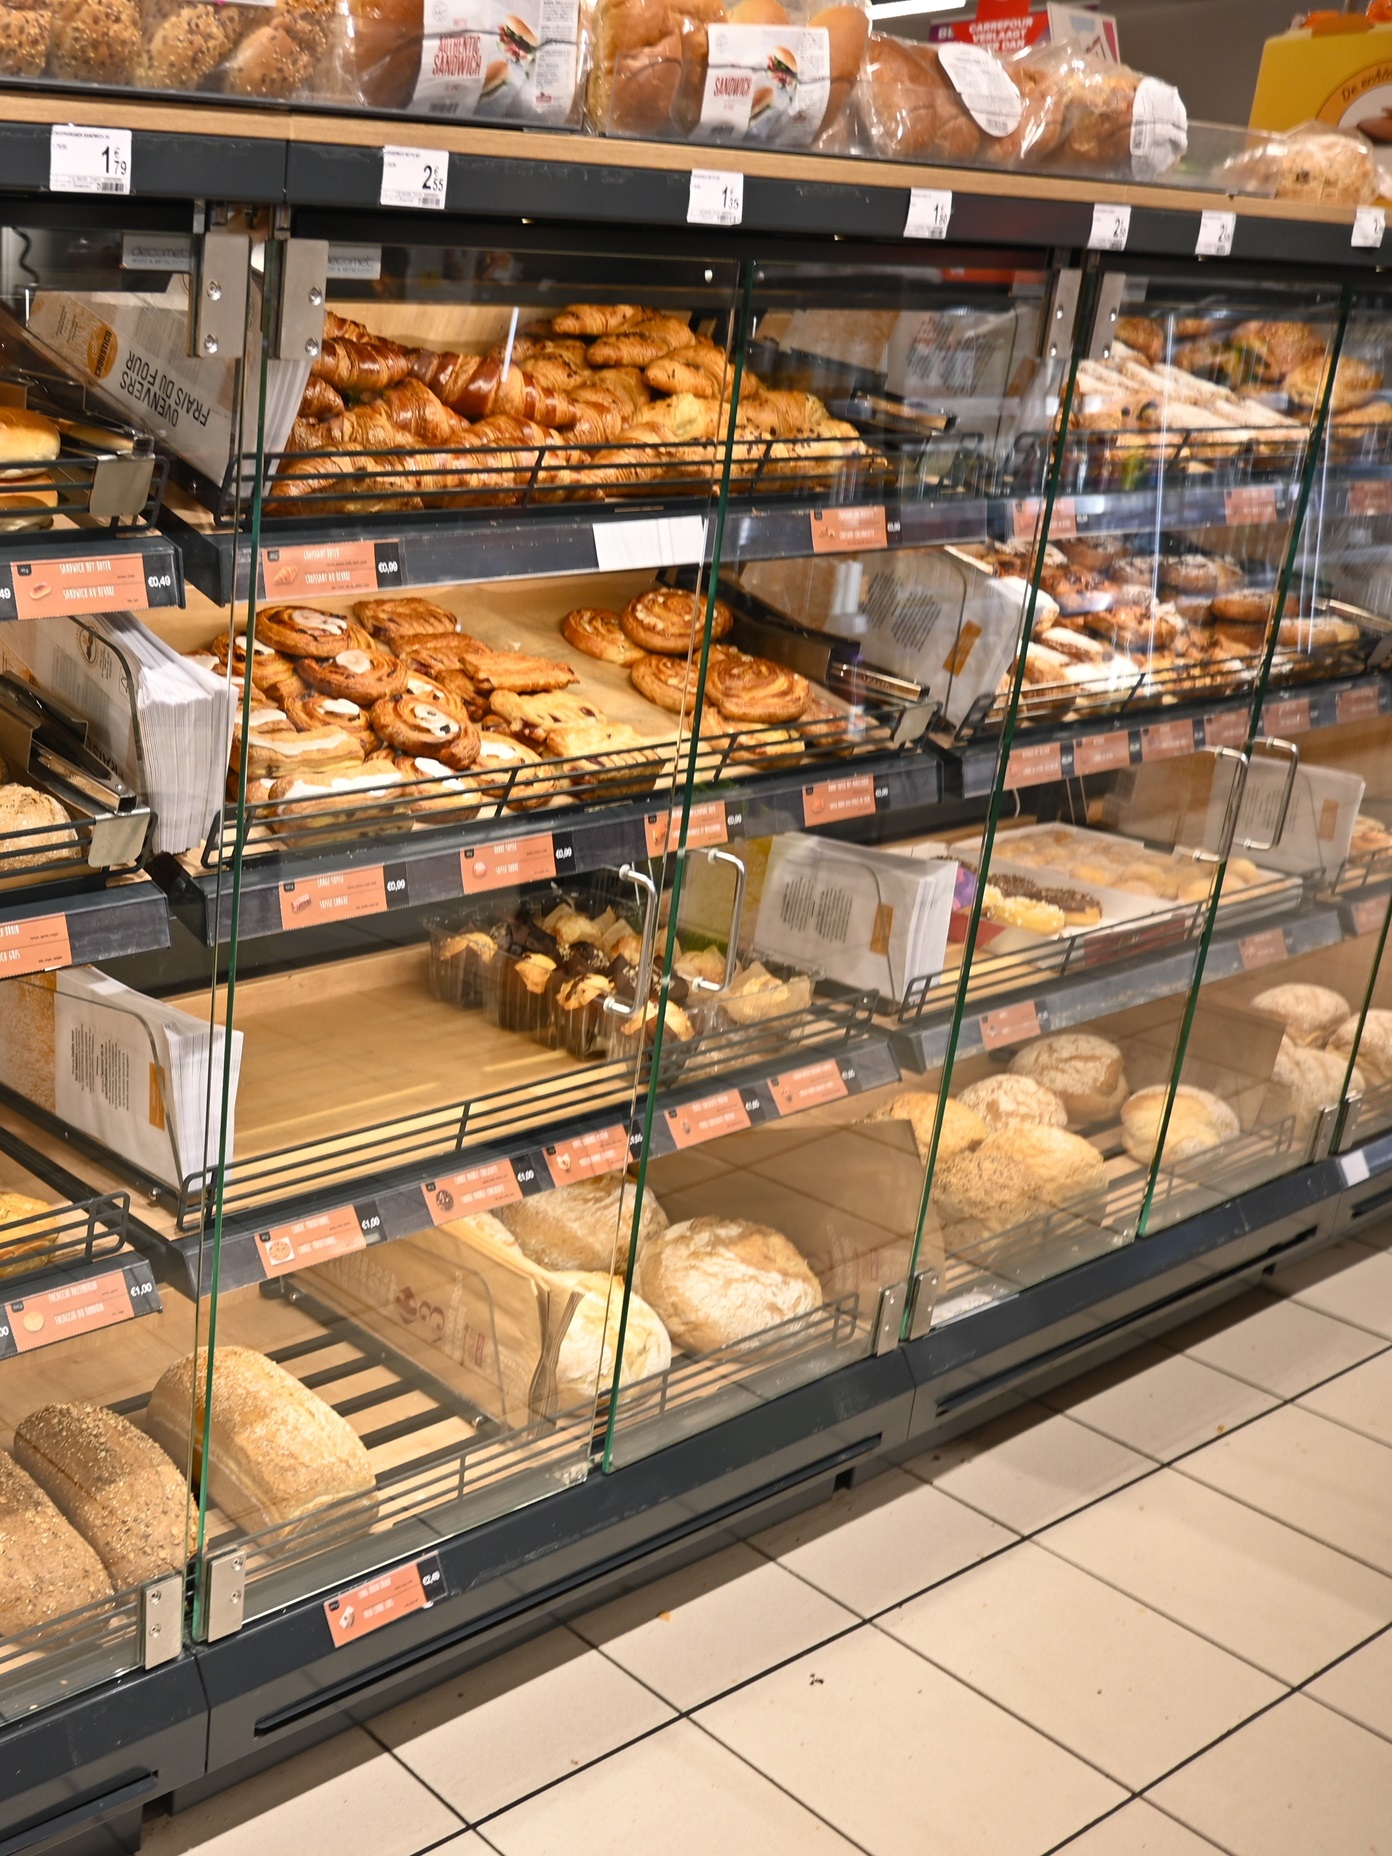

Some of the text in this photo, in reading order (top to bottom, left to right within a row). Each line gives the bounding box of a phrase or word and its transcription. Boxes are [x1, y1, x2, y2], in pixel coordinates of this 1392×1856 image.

[969, 16, 1033, 34] CARREFOUR
[439, 35, 481, 55] AUTHENTIC
[972, 28, 1027, 43] VERLAAGT
[432, 54, 482, 77] SANDWICH
[714, 76, 753, 97] SANDWICH
[102, 146, 110, 174] 1
[114, 160, 127, 175] 79
[422, 165, 432, 190] 2
[95, 330, 112, 378] CROUSTICO
[125, 350, 211, 427] FRAIS DU FOUR
[120, 372, 179, 428] OVENVERS
[59, 563, 85, 575] SANDWICH
[148, 575, 171, 589] €0,49
[63, 588, 88, 600] SANDWICH
[131, 1282, 153, 1297] €1,00
